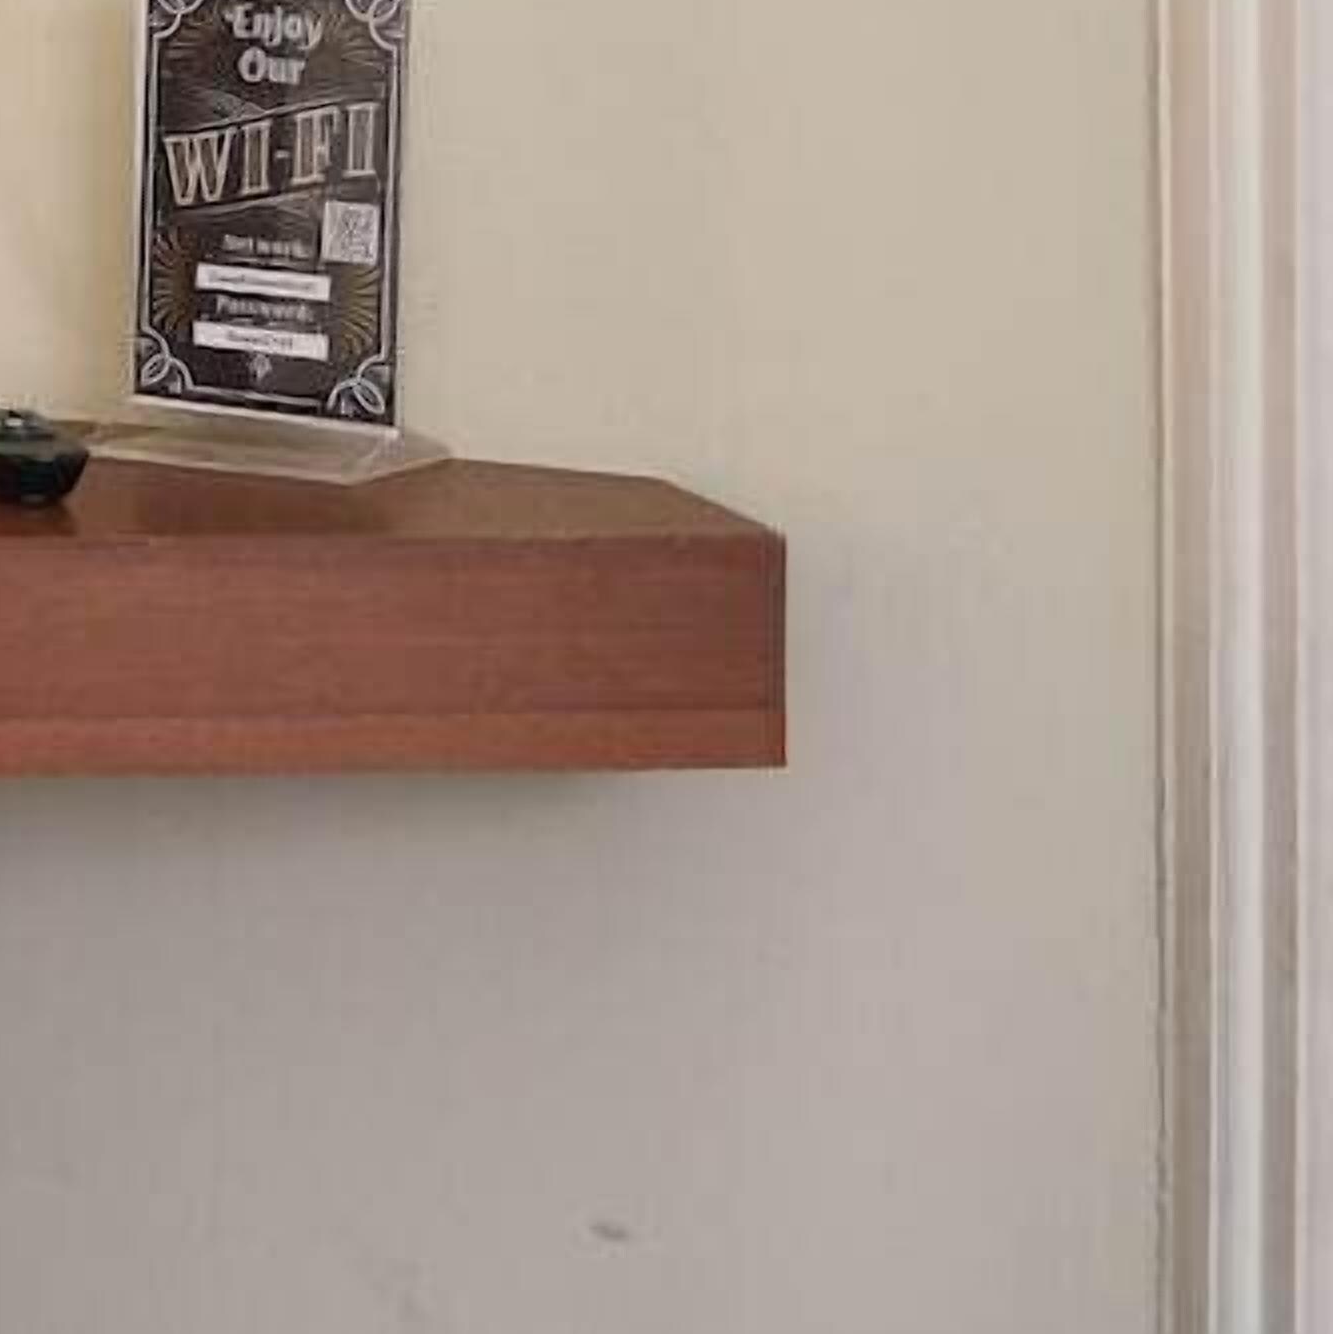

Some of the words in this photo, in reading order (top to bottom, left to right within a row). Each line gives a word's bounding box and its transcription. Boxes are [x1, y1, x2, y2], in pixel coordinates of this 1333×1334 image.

[225, 4, 323, 50] Enjoy
[237, 46, 306, 84] Our
[162, 100, 379, 205] WI-FI
